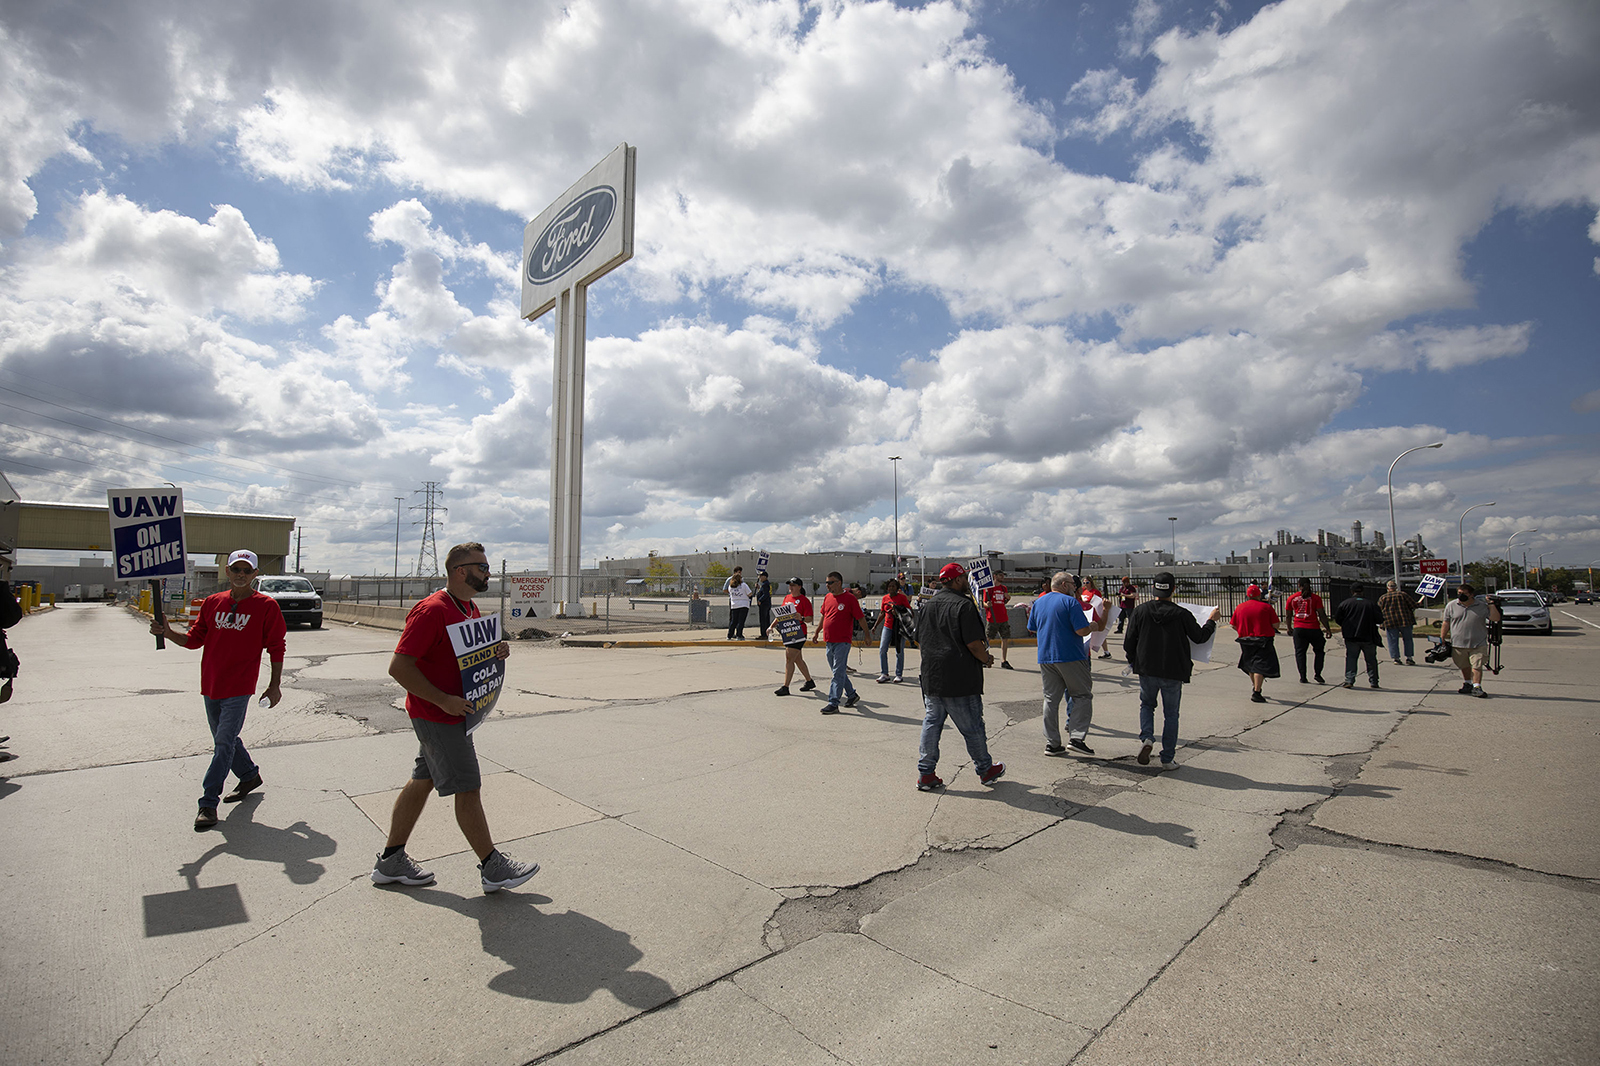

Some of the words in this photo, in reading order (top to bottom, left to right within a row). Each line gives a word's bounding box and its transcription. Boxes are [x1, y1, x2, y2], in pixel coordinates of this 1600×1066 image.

[541, 205, 596, 273] Ford
[112, 495, 178, 518] UAW
[136, 524, 161, 548] ON
[119, 540, 182, 575] STRIKE
[969, 559, 987, 569] UAW
[1424, 575, 1443, 584] UAW
[775, 604, 791, 615] UAW
[215, 620, 247, 632] STRONG
[459, 617, 497, 649] UAW
[783, 620, 796, 628] COLA
[461, 649, 492, 667] STAND
[472, 663, 498, 683] COLA
[465, 684, 488, 702] FAIR
[488, 674, 504, 692] PAY
[475, 690, 496, 711] NOW
